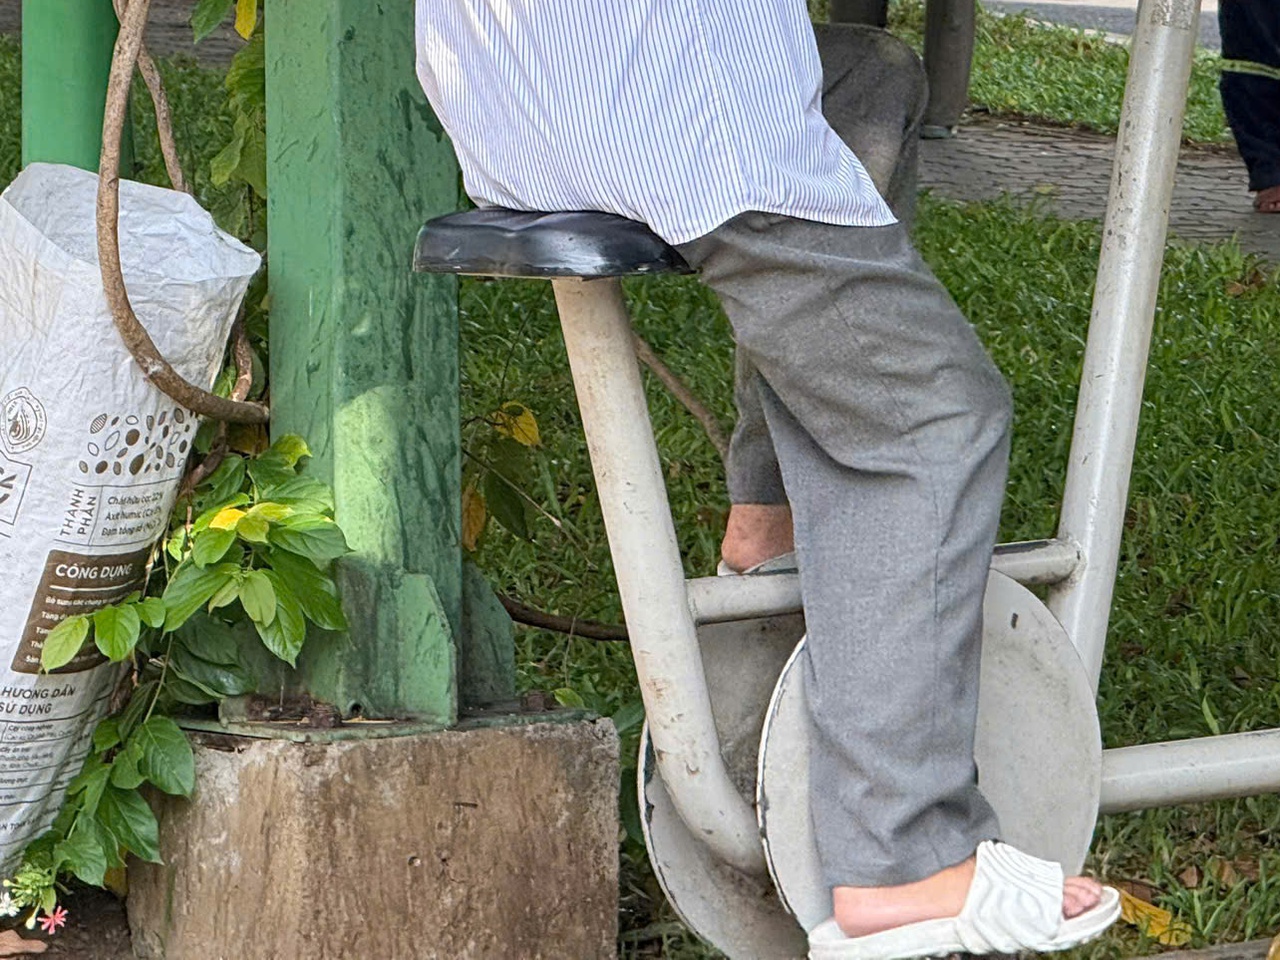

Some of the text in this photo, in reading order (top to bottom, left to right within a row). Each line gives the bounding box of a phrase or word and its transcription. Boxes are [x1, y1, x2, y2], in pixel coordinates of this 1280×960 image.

[56, 562, 133, 580] CÔNG DỤNG
[19, 703, 52, 716] DỤNG
